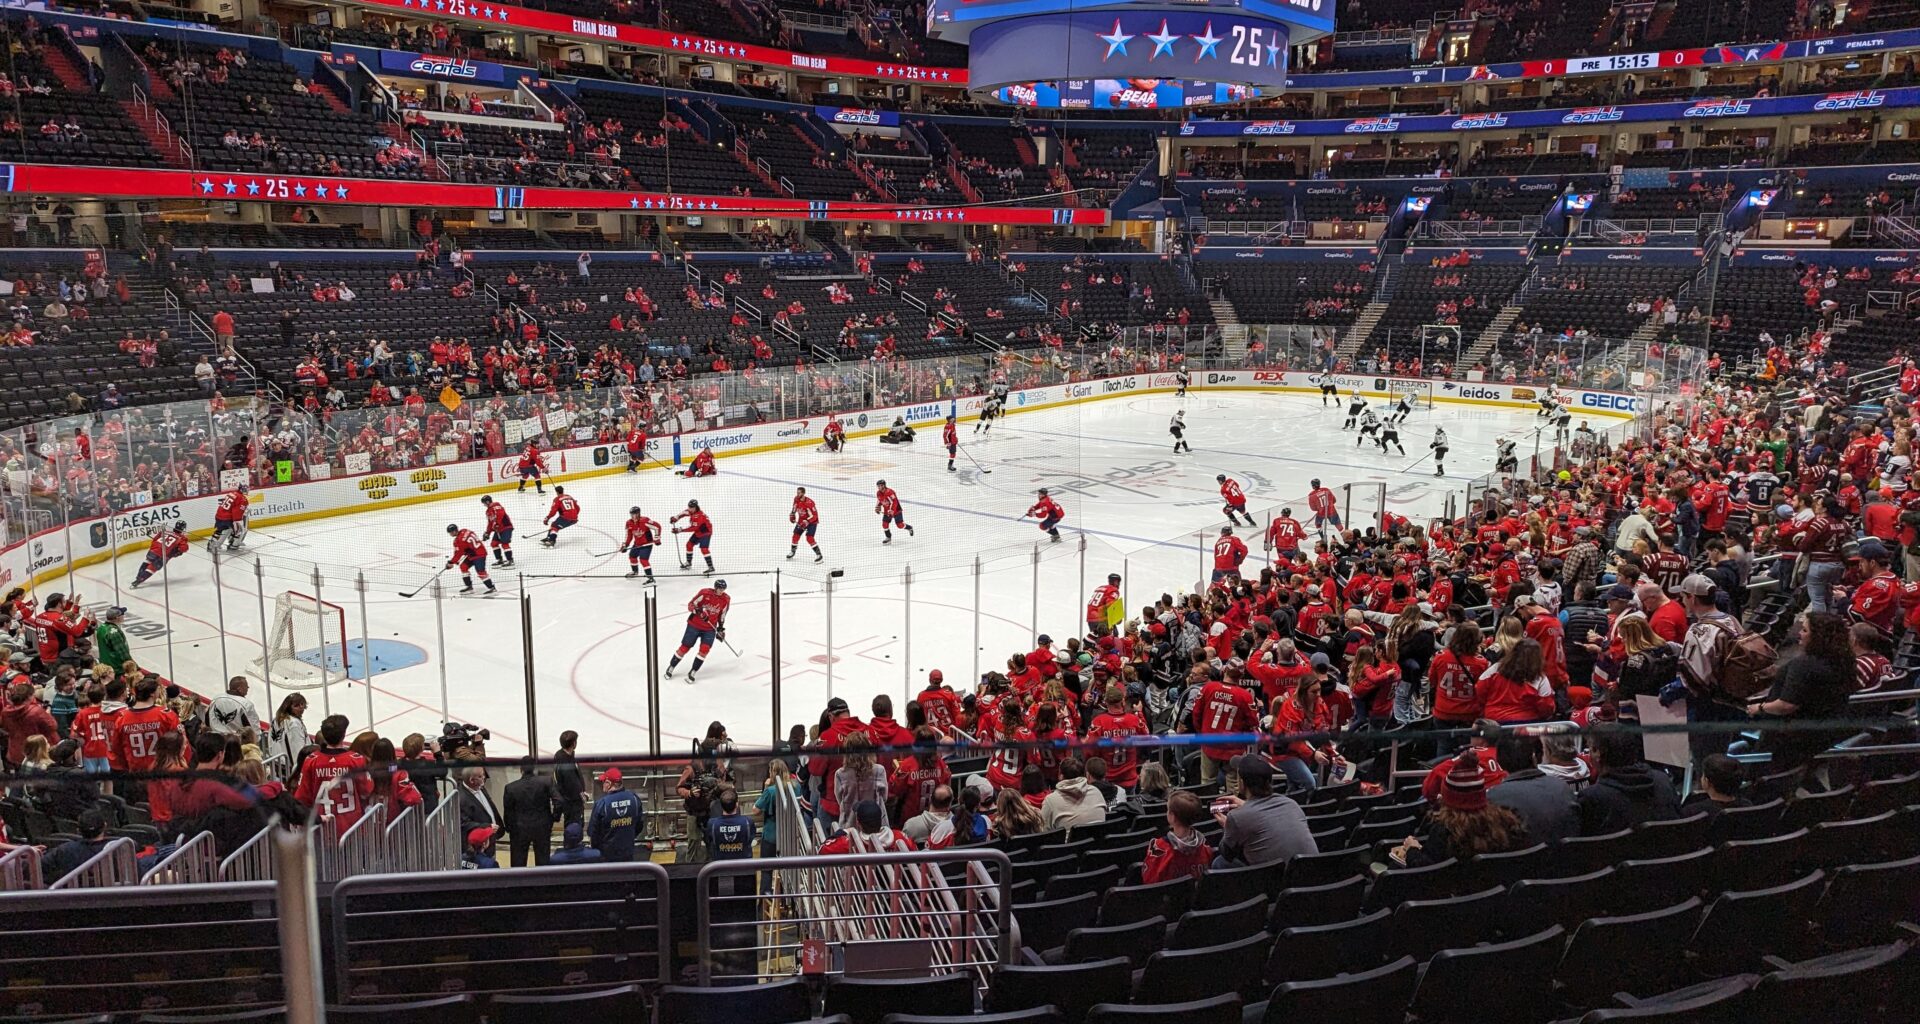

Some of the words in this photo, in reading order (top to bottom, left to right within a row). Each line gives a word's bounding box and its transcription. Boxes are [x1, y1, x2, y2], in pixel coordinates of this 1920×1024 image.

[450, 0, 465, 15] 25
[573, 20, 597, 35] ETHAN
[598, 25, 617, 38] BEAR
[704, 40, 716, 53] 25
[1231, 26, 1262, 67] 25
[1818, 46, 1825, 54] 0
[791, 55, 810, 67] ETHAN
[810, 57, 827, 69] BEAR
[1581, 61, 1600, 70] PRE
[1609, 55, 1650, 69] 15:15
[1674, 52, 1684, 64] 0
[907, 67, 918, 79] 25
[1544, 63, 1552, 73] 0
[1120, 89, 1157, 103] BEAR
[266, 179, 289, 198] 25
[671, 196, 683, 209] 25
[922, 209, 934, 221] 25
[1122, 377, 1136, 389] AG
[1252, 372, 1286, 381] DEX
[1072, 386, 1092, 397] Giant
[1459, 386, 1500, 399] leidos
[1582, 393, 1646, 412] GEICO
[906, 404, 941, 421] AKIMA
[611, 438, 659, 457] CARS
[692, 433, 752, 450] ticketmaster
[1757, 486, 1768, 501] 8
[248, 507, 266, 517] tar
[267, 500, 305, 514] Health
[562, 499, 575, 510] 67
[1717, 497, 1724, 513] 3
[115, 504, 181, 531] CAESARS
[1279, 523, 1295, 537] 74
[1657, 571, 1682, 589] 70
[1863, 597, 1873, 609] 8
[1440, 672, 1475, 699] 43
[1214, 691, 1234, 701] OSHIE
[926, 706, 952, 726] 43
[1210, 701, 1239, 730] 77
[123, 721, 161, 733] KUZNETSOV
[1103, 728, 1137, 739] OVECHKIN
[128, 731, 159, 757] 92
[315, 766, 349, 778] WILSON
[316, 777, 356, 815] 43
[611, 800, 619, 808] ICE
[619, 799, 631, 807] CREW
